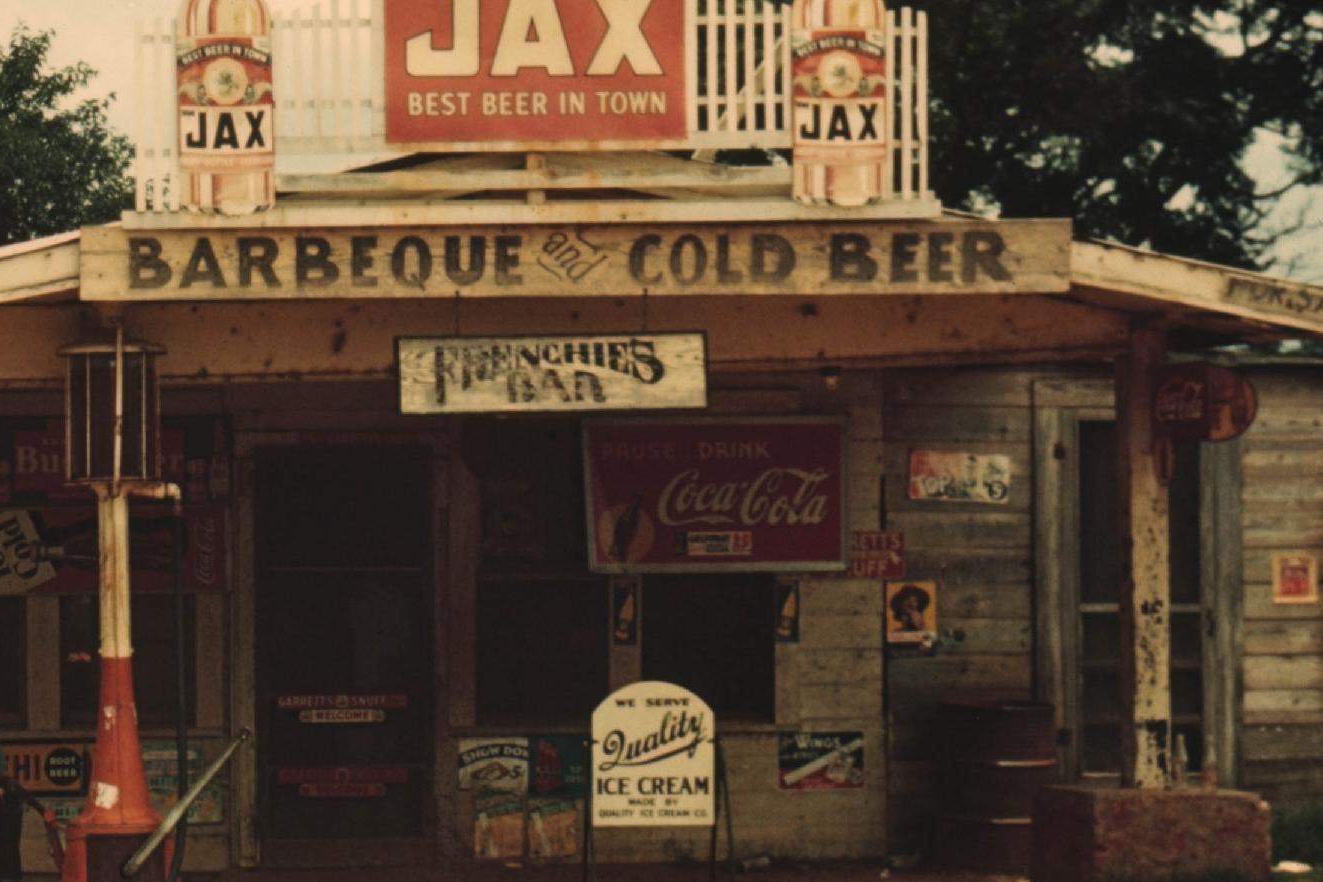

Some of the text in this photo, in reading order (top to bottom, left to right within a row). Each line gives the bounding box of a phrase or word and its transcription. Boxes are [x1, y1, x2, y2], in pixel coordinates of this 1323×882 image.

[405, 0, 664, 77] JAX
[204, 44, 230, 57] BEER
[232, 45, 242, 56] IN
[407, 90, 667, 118] BEST BEER IN TOWN
[186, 111, 266, 149] JAX
[800, 103, 878, 141] JAX
[128, 230, 1014, 291] BARBEQUE and COLD BEER
[434, 339, 665, 405] FRENCHIES
[506, 368, 608, 403] BAR
[696, 441, 772, 459] DRINK
[658, 467, 831, 526] Coca-Cola
[848, 560, 886, 577] UFF
[350, 695, 387, 707] SNUFF
[615, 698, 690, 707] WE SERVE
[315, 711, 369, 720] WELCOME
[599, 710, 708, 771] Quality
[49, 756, 76, 766] ROOT
[462, 747, 501, 764] SHOW
[49, 768, 78, 777] BEER
[597, 777, 710, 795] ICE CREAM
[628, 798, 678, 806] MADE BY
[599, 809, 634, 818] QUALITY
[640, 809, 654, 817] ICE
[658, 809, 690, 817] CREAM
